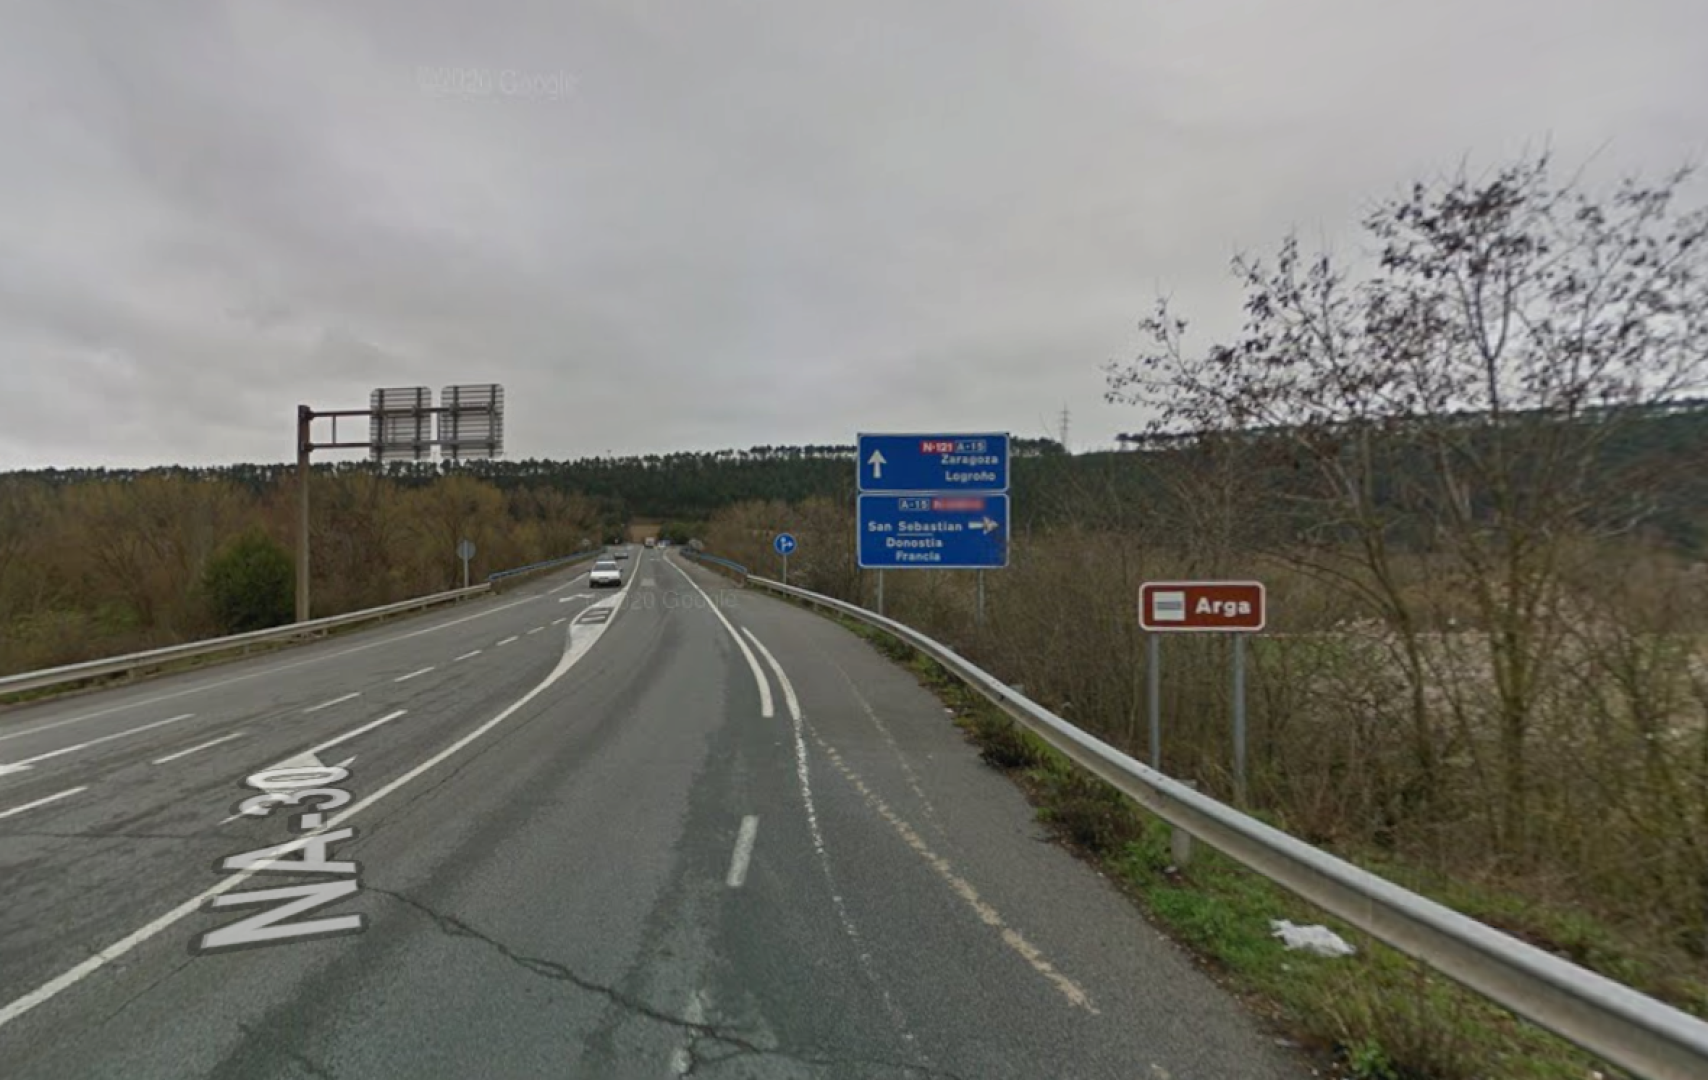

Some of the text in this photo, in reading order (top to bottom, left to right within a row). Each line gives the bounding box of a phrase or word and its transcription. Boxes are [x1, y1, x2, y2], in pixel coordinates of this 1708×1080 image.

[922, 442, 985, 453] N-121 A-15
[941, 455, 998, 466] Zaragoza
[945, 471, 996, 482] Logroño
[901, 500, 928, 511] A-15
[868, 521, 963, 532] San Sebastian
[886, 537, 943, 548] Donostia
[896, 552, 941, 562] Francia
[1195, 597, 1252, 618] Arga
